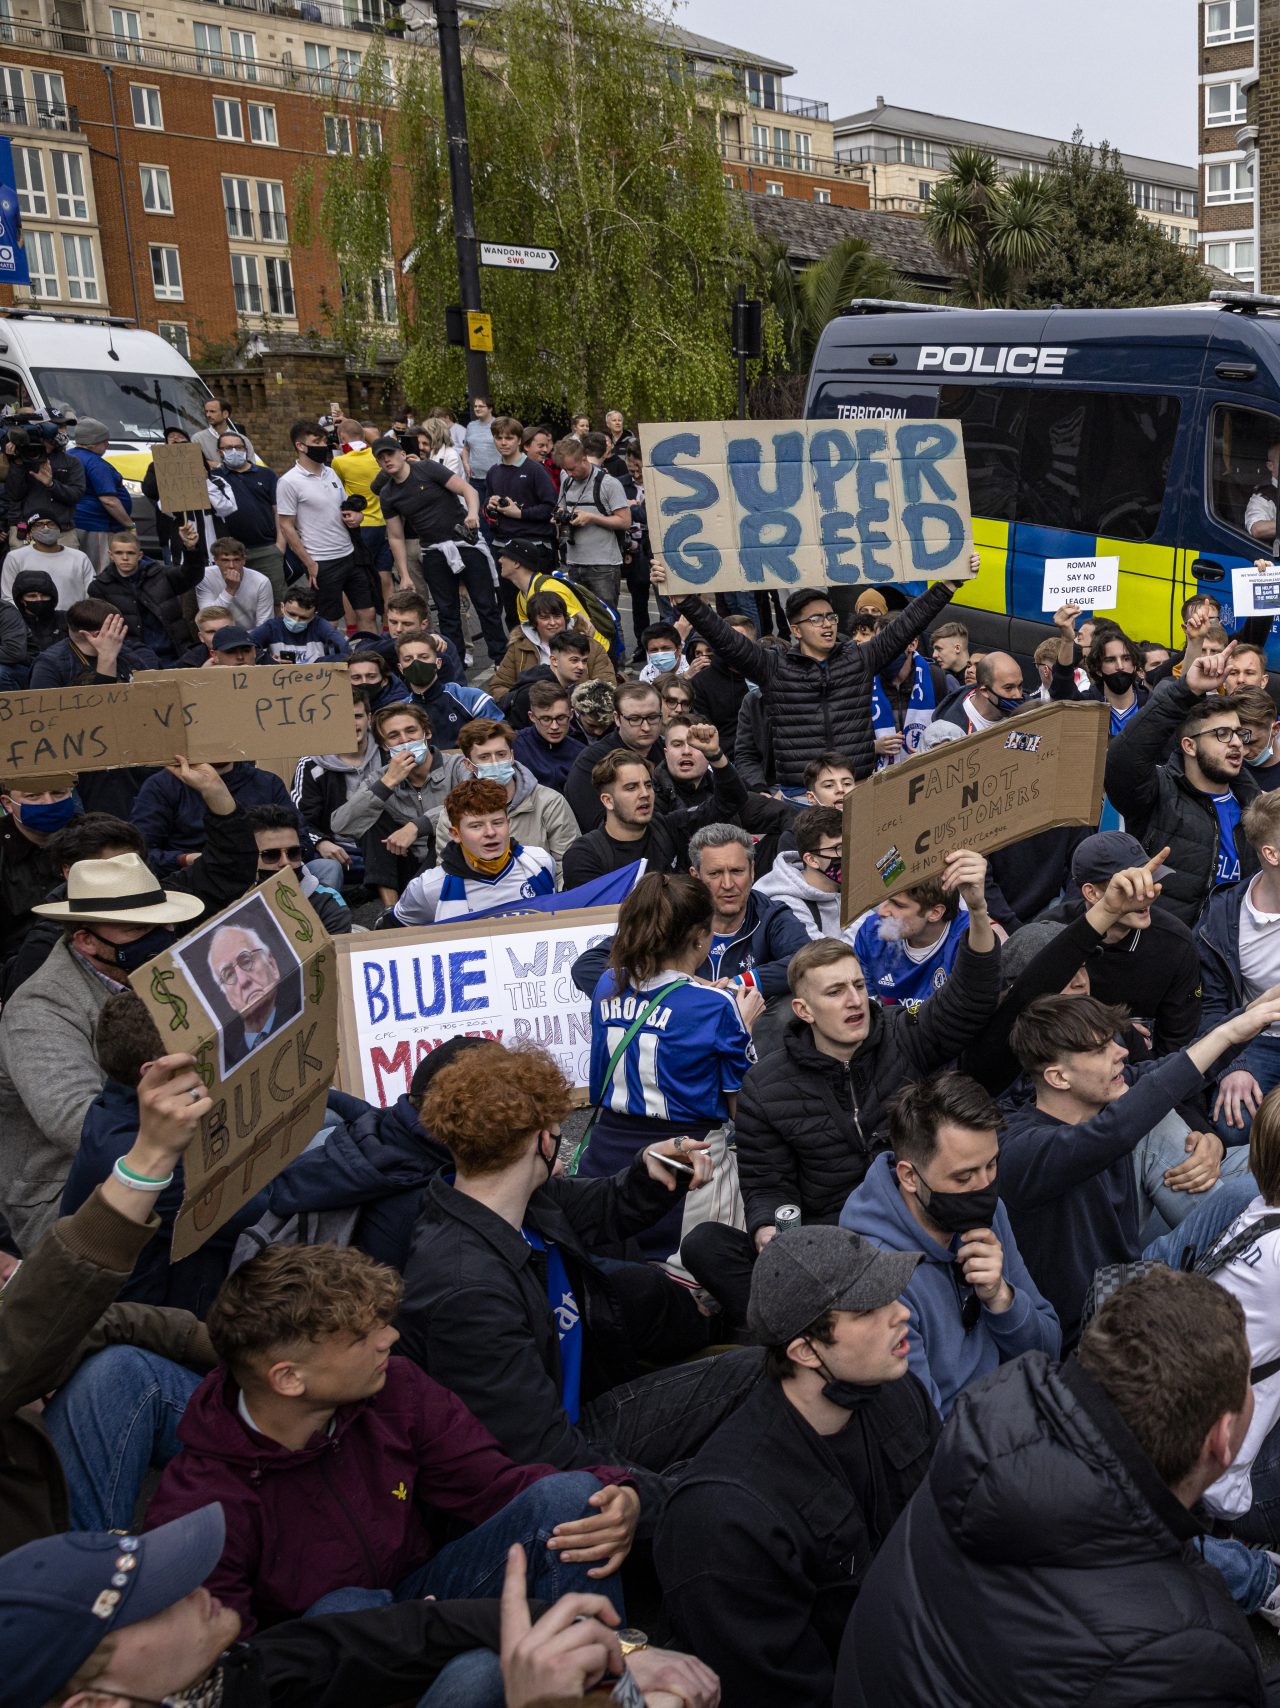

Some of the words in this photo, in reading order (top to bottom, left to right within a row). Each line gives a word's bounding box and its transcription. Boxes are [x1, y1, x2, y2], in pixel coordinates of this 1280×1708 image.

[484, 246, 521, 256] WANDON
[524, 251, 547, 259] ROAD
[917, 345, 1068, 375] POLICE
[650, 423, 958, 516] SUPER
[663, 502, 966, 586] GREED
[1066, 561, 1097, 569] ROMAN
[1060, 586, 1086, 594] SUPER
[1087, 584, 1112, 593] GREED
[1083, 573, 1096, 581] NO
[1065, 597, 1095, 605] LEAGUE
[232, 672, 248, 690] 12
[272, 667, 334, 692] Greedy
[255, 693, 341, 732] PIGS
[5, 724, 109, 770] FANS
[908, 748, 981, 805] FANS
[961, 763, 1019, 809] NOT
[914, 778, 1040, 855] CUSTOMERS
[362, 949, 490, 1026] BLUE
[503, 980, 547, 1011] THE
[203, 1021, 323, 1173] BUCK
[192, 1078, 321, 1231] OFF
